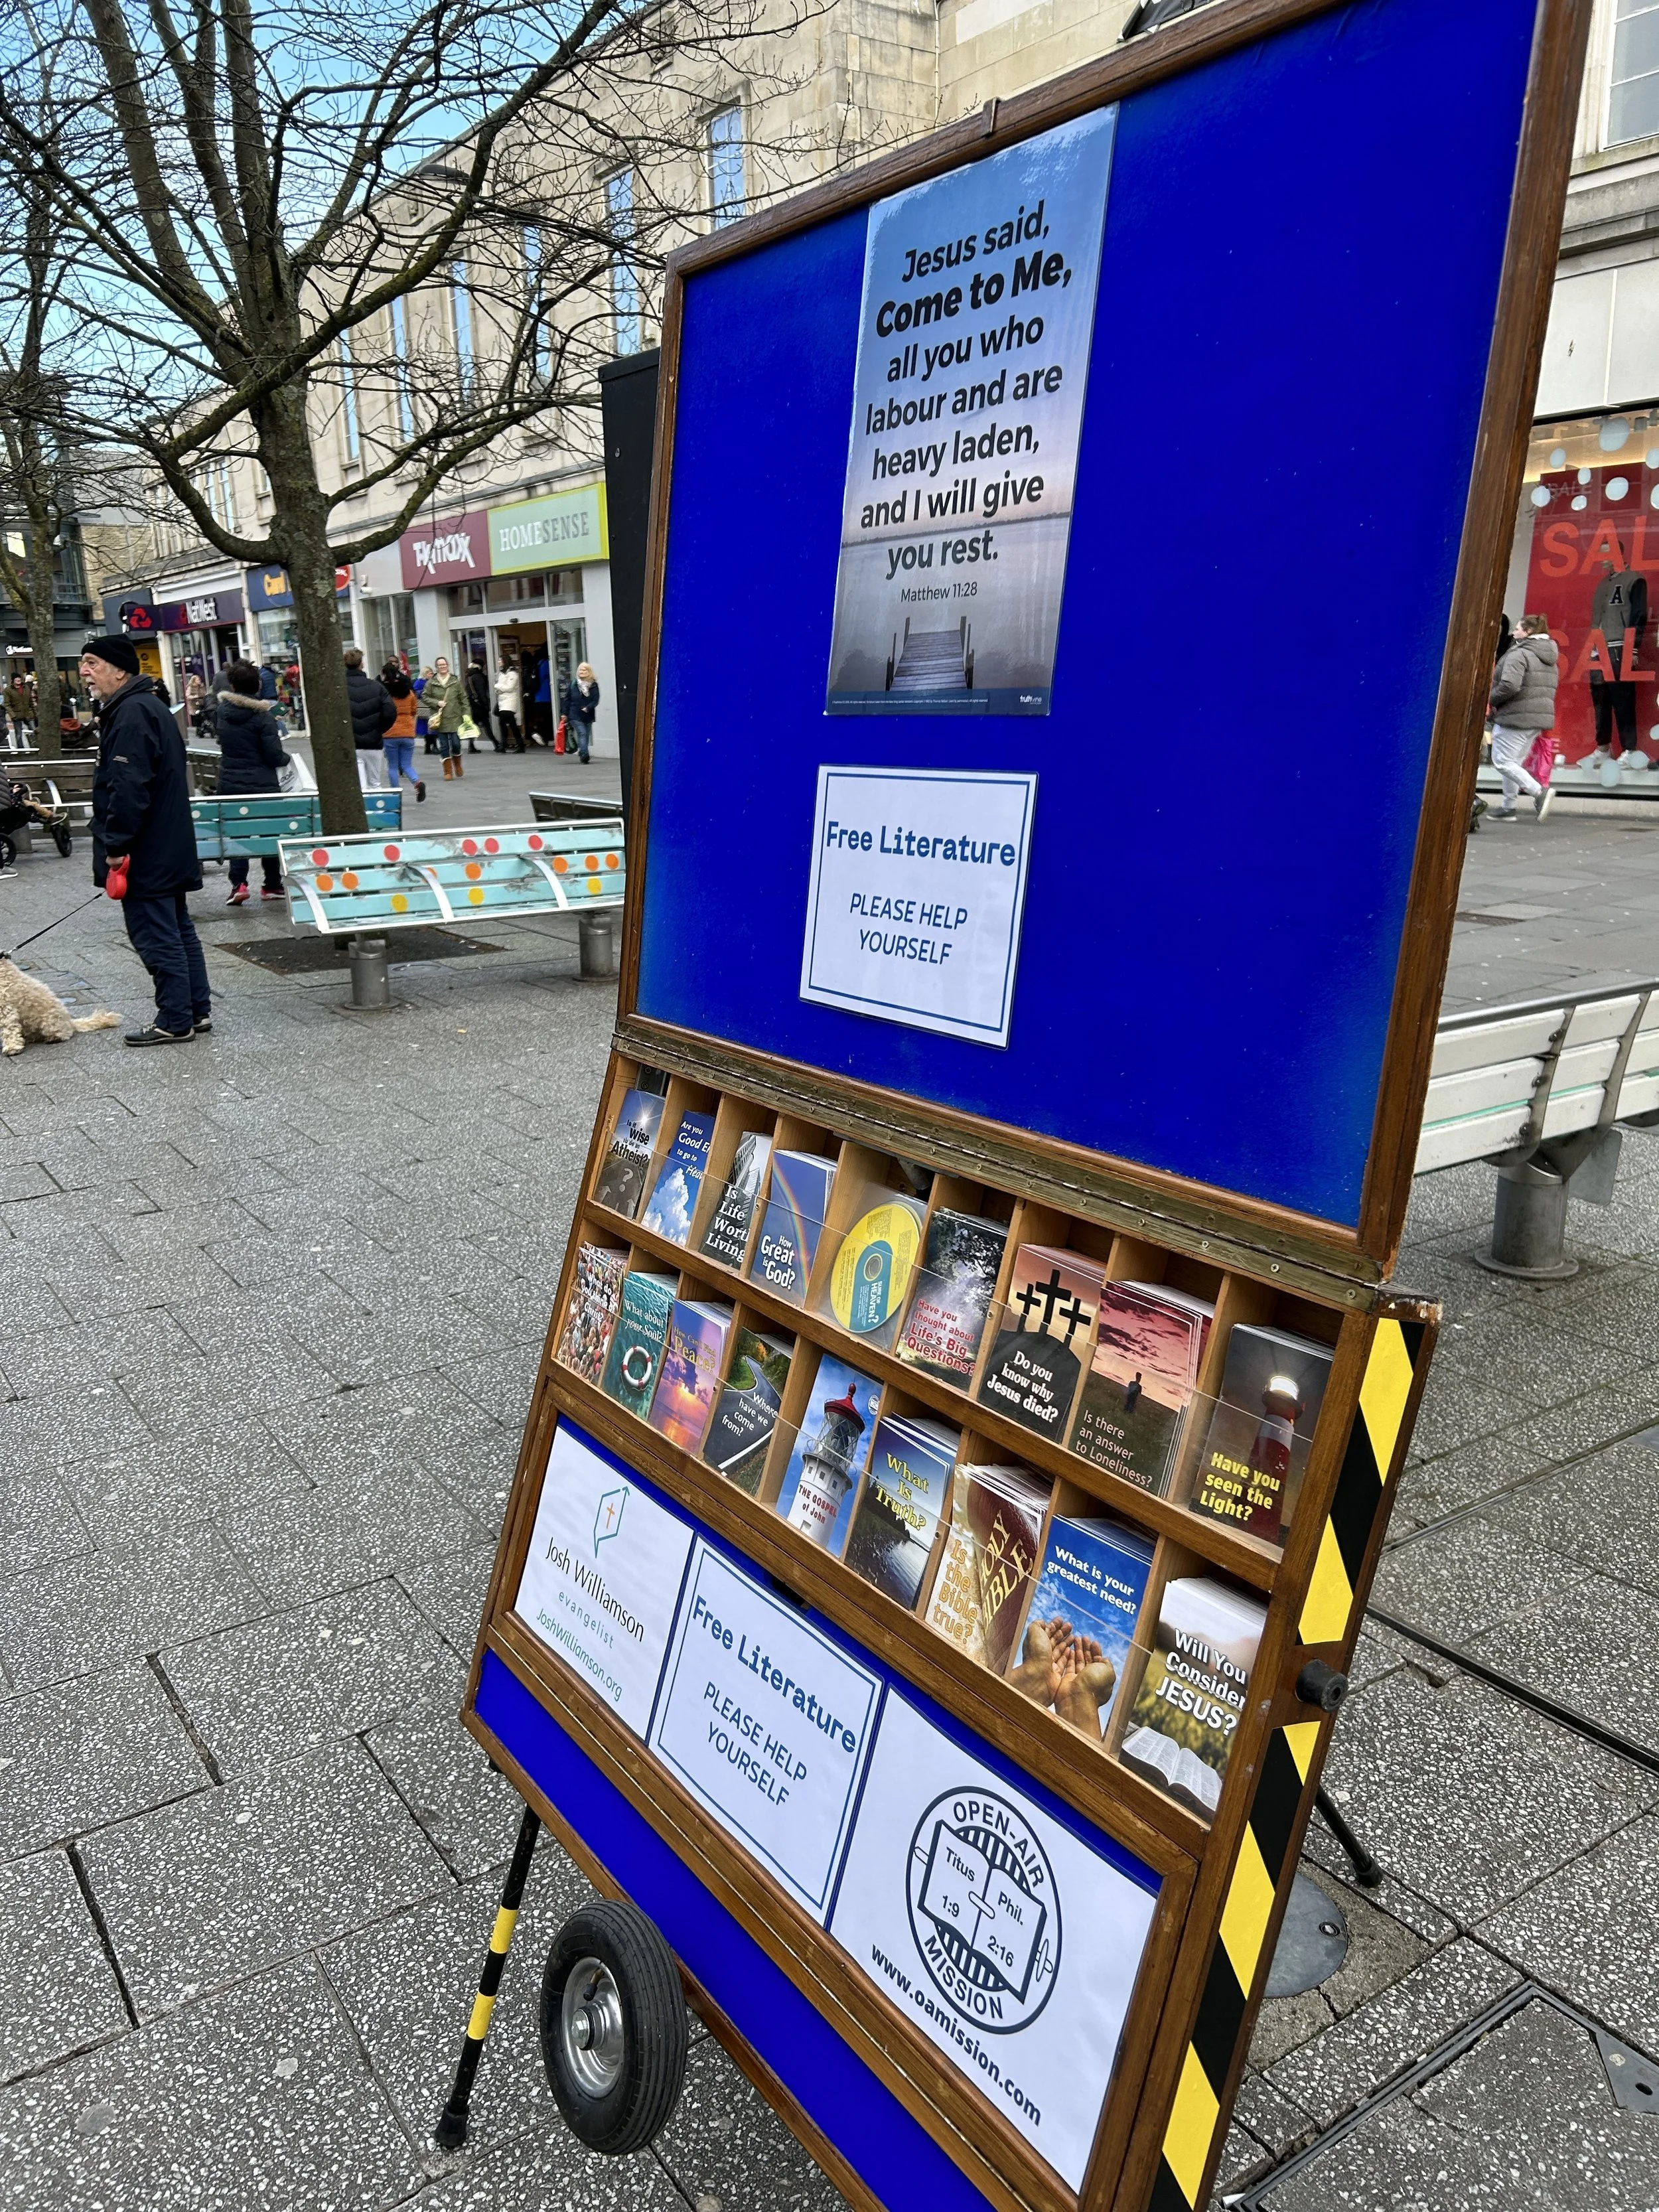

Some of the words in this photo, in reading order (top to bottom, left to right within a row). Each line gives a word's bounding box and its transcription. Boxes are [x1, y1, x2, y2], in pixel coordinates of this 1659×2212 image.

[902, 235, 976, 282] Jesus
[983, 199, 1050, 256] said,
[877, 286, 962, 337] Come
[970, 272, 1004, 310] to
[1011, 252, 1072, 297] Me,
[887, 342, 918, 382] all
[922, 337, 972, 381] you
[980, 315, 1044, 357] who
[866, 393, 946, 435] labour
[952, 369, 1006, 415] and
[1013, 365, 1062, 399] are
[872, 441, 947, 480] heavy
[952, 422, 1039, 464] laden,
[861, 490, 906, 528] and
[913, 490, 920, 520] I
[928, 478, 976, 518] will
[983, 470, 1044, 518] give
[499, 512, 589, 552] HOMESENSE
[885, 540, 933, 580] you
[940, 530, 998, 566] rest.
[901, 583, 950, 603] Matthew
[952, 581, 977, 598] 11:28
[1609, 584, 1624, 605] A
[827, 821, 873, 851] Free
[880, 826, 1015, 866] Literature
[850, 893, 916, 922] PLEASE
[919, 903, 968, 930] HELP
[860, 929, 952, 964] YOURSELF
[630, 1128, 649, 1145] wise
[679, 1132, 702, 1149] Good
[681, 1121, 691, 1130] Are
[691, 1126, 703, 1135] you
[611, 1141, 648, 1167] Atheist?
[691, 1153, 697, 1162] to
[725, 1185, 739, 1199] Is
[719, 1201, 745, 1220] Life
[705, 1232, 746, 1262] Living
[761, 1235, 795, 1266] Great
[779, 1235, 792, 1248] How
[762, 1256, 768, 1266] is
[766, 1260, 796, 1290] God?
[587, 1273, 603, 1290] What
[603, 1282, 613, 1295] do
[584, 1301, 604, 1323] Christ?
[624, 1299, 643, 1317] What
[644, 1309, 664, 1328] about
[868, 1282, 879, 1323] HEAVEN?
[917, 1299, 939, 1314] Have
[941, 1311, 958, 1322] you
[624, 1318, 643, 1333] your
[642, 1325, 662, 1341] Soul?
[687, 1334, 698, 1346] Can
[910, 1321, 943, 1346] Life's
[946, 1337, 968, 1359] Big
[914, 1311, 948, 1331] thought
[948, 1327, 974, 1343] about
[674, 1335, 715, 1375] Peace?
[906, 1335, 976, 1376] Questions?
[1013, 1350, 1031, 1370] Do
[1032, 1361, 1054, 1382] you
[987, 1374, 1021, 1404] Jesus
[1023, 1395, 1059, 1424] died?
[1001, 1363, 1031, 1388] know
[1031, 1380, 1054, 1402] why
[734, 1412, 755, 1431] come
[739, 1397, 757, 1417] have
[757, 1414, 768, 1427] we
[753, 1392, 778, 1418] Where
[721, 1414, 744, 1436] from?
[1083, 1409, 1092, 1423] Is
[1095, 1415, 1125, 1439] there
[1079, 1428, 1092, 1441] an
[1094, 1435, 1134, 1461] answer
[887, 1451, 929, 1494] What
[1076, 1439, 1088, 1454] to
[1090, 1444, 1153, 1488] Loneliness?
[1210, 1451, 1250, 1479] Have
[1252, 1469, 1281, 1493] you
[798, 1484, 812, 1500] THE
[812, 1494, 837, 1518] GOSPEL
[875, 1485, 926, 1531] Truth?
[897, 1478, 912, 1502] Is
[1200, 1490, 1254, 1522] Light?
[1205, 1473, 1242, 1499] seen
[1247, 1487, 1273, 1510] the
[802, 1503, 810, 1512] of
[810, 1507, 826, 1524] John
[951, 1539, 967, 1565] Is
[946, 1562, 971, 1593] the
[1047, 1560, 1098, 1595] greatest
[1100, 1587, 1137, 1615] need?
[1054, 1544, 1089, 1575] What
[1092, 1566, 1102, 1580] is
[1104, 1573, 1135, 1597] your
[545, 1536, 569, 1575] Josh
[575, 1558, 645, 1643] Williamson
[938, 1583, 978, 1624] Bible
[558, 1589, 614, 1650] evangelist
[933, 1605, 974, 1645] true?
[536, 1607, 622, 1703] JoshWilliamson.org
[1174, 1627, 1208, 1664] Will
[1213, 1649, 1247, 1686] You
[692, 1594, 733, 1651] Free
[737, 1633, 857, 1753] Literature
[1165, 1651, 1247, 1708] Consider
[1155, 1675, 1238, 1737] JESUS?
[703, 1681, 763, 1747] PLEASE
[764, 1728, 808, 1782] HELP
[707, 1721, 790, 1806] YOURSELF
[953, 1800, 1045, 1888] OPEN-AIR
[945, 1846, 976, 1882] Titus
[941, 1893, 960, 1917] 1:9
[997, 1890, 1024, 1927] Phil.
[987, 1935, 1015, 1967] 2:16
[923, 1935, 1004, 2021] MISSION
[871, 1943, 1042, 2127] www.oamission.com
